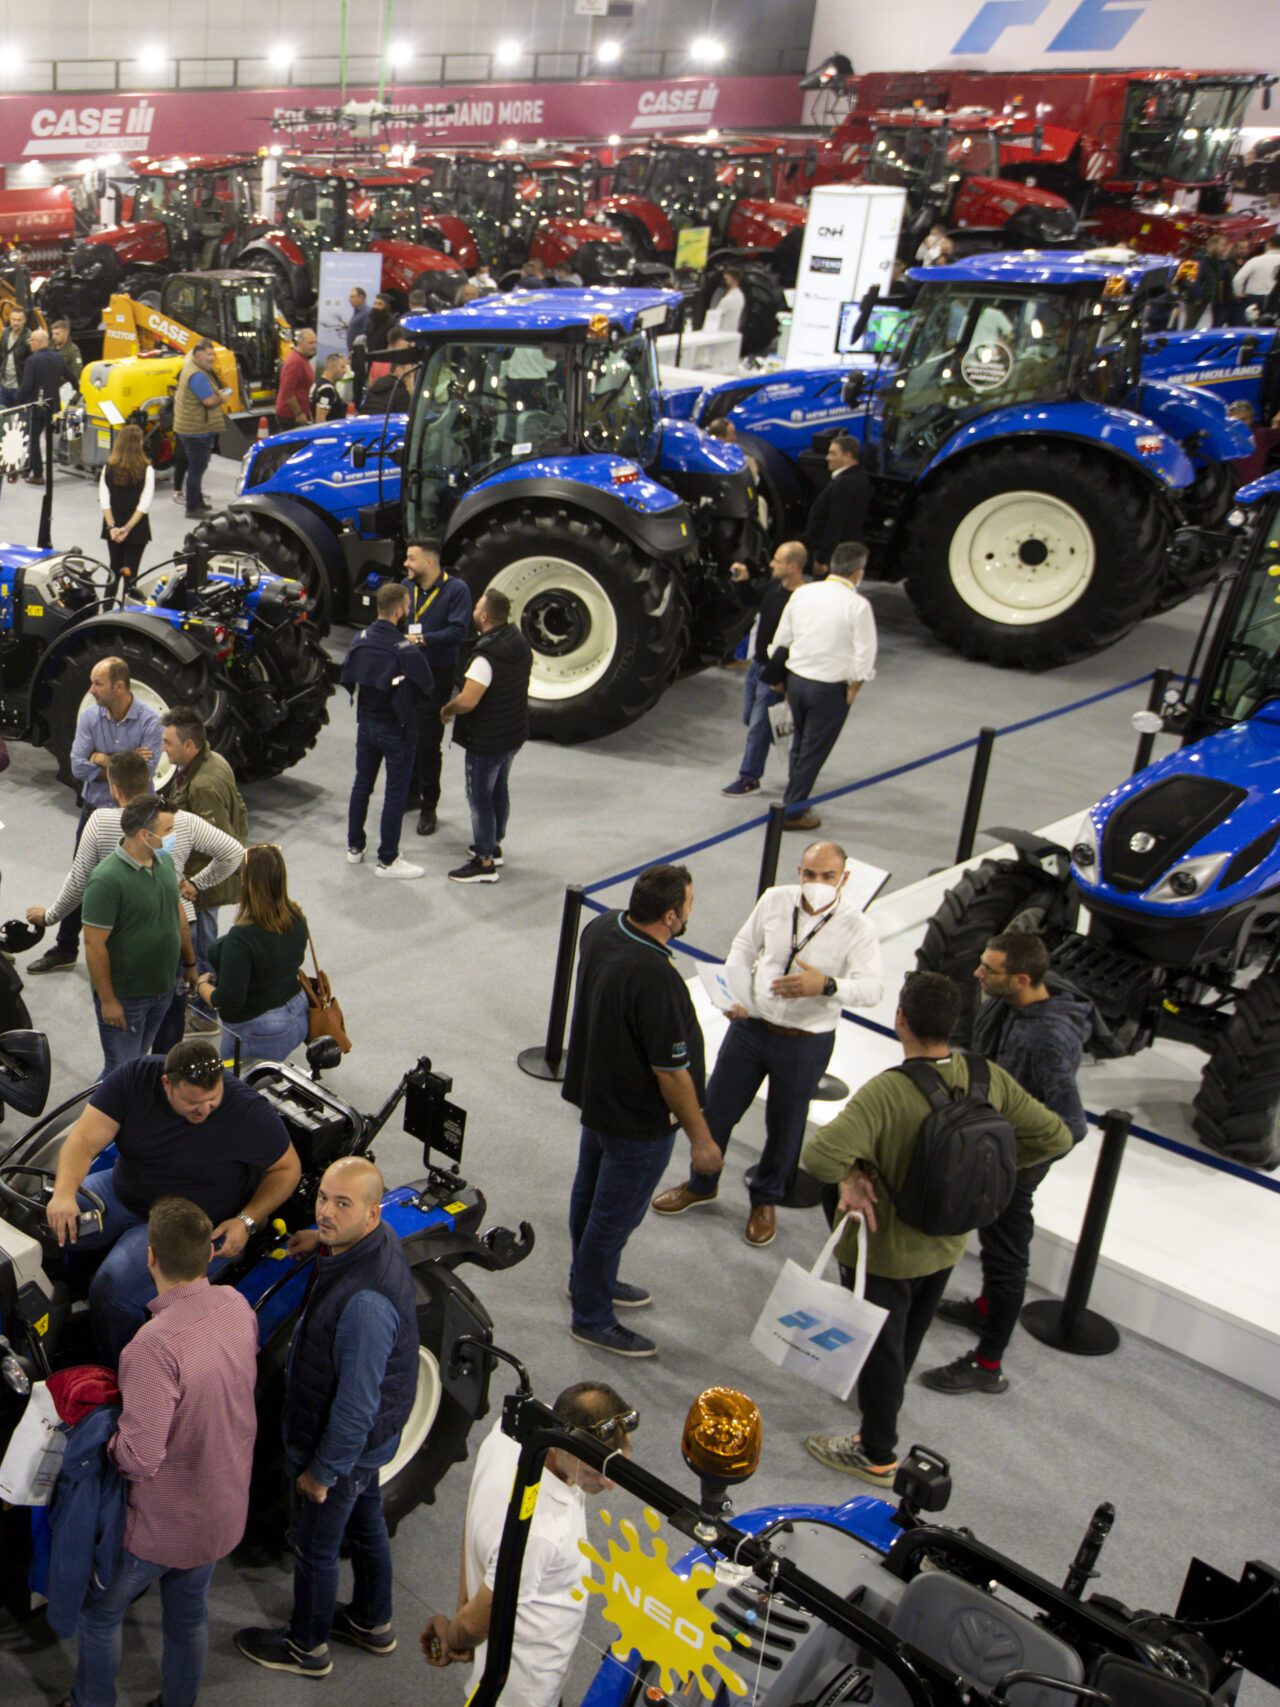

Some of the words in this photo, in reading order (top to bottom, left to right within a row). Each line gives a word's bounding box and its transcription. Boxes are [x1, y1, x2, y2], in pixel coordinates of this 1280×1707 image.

[497, 99, 544, 125] MORE
[637, 90, 699, 114] CASE
[31, 107, 124, 137] CASE
[148, 314, 190, 346] CASE
[1199, 365, 1263, 380] HOLLAND
[612, 1571, 705, 1650] NEO
